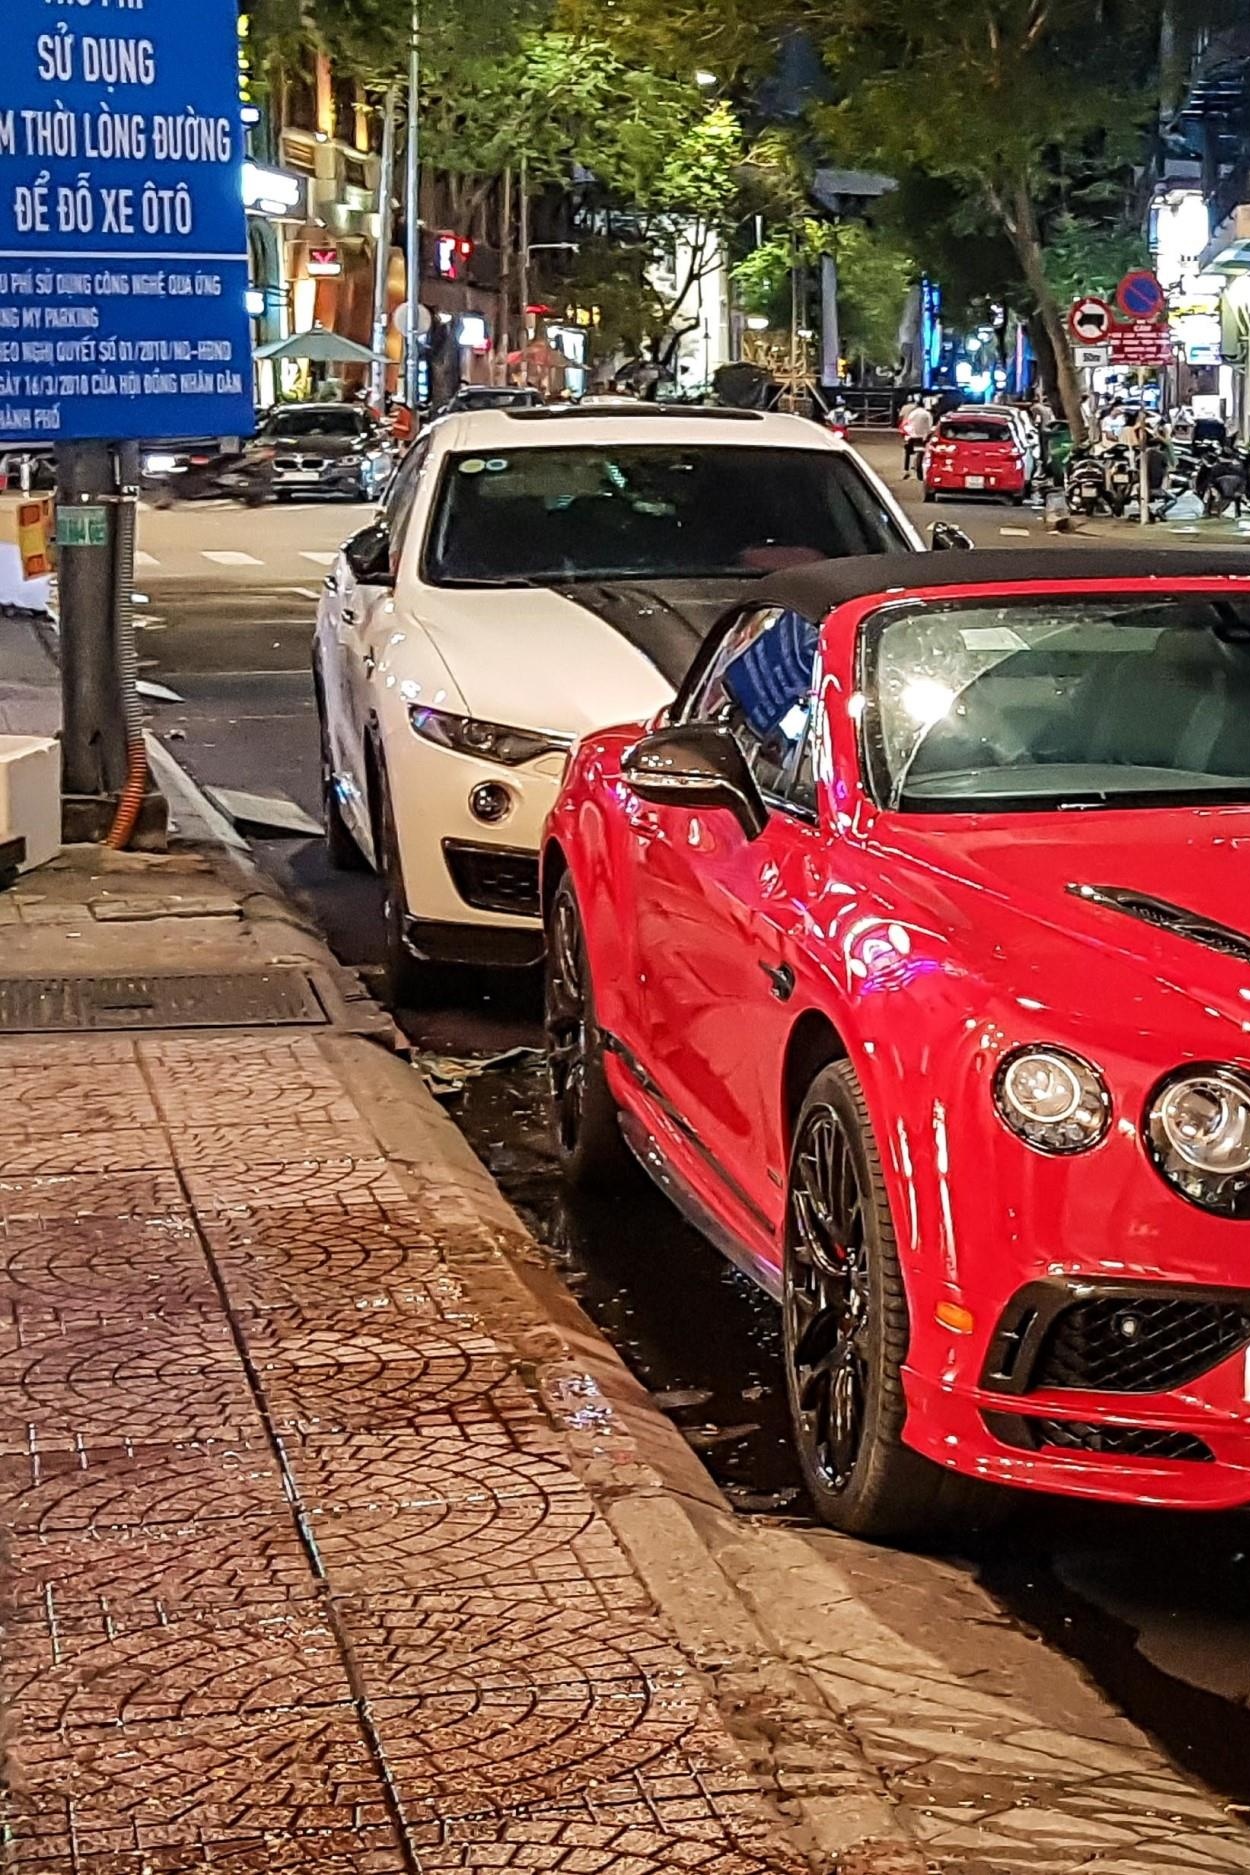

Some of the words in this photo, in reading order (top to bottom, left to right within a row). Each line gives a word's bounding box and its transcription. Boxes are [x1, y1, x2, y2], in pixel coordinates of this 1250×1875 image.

[37, 22, 75, 80] SỬ
[82, 36, 155, 93] DỤNG
[21, 99, 77, 157] THỜI
[85, 101, 145, 159] LÒNG
[152, 105, 231, 162] ĐƯỜNG
[14, 170, 50, 232] ĐỂ
[57, 172, 94, 233] ĐỖ
[100, 188, 135, 233] XE
[142, 180, 192, 234] ÔTÔ
[11, 269, 34, 295] PHÍ
[56, 273, 92, 299] DỤNG
[94, 270, 130, 295] CÔNG
[132, 270, 167, 298] NGHỆ
[168, 275, 192, 295] QUA
[195, 270, 221, 296] ỨNG
[22, 307, 42, 328] MY
[44, 307, 99, 328] PARKING
[22, 341, 54, 366] NGHỊ
[56, 336, 96, 362] QUYẾT
[99, 336, 118, 362] SỐ
[92, 369, 118, 394] CỦA
[119, 371, 141, 399] HỘI
[144, 368, 177, 394] ĐỒNG
[180, 371, 214, 394] NHÂN
[216, 370, 242, 394] DÂN
[34, 402, 61, 429] PHỐ
